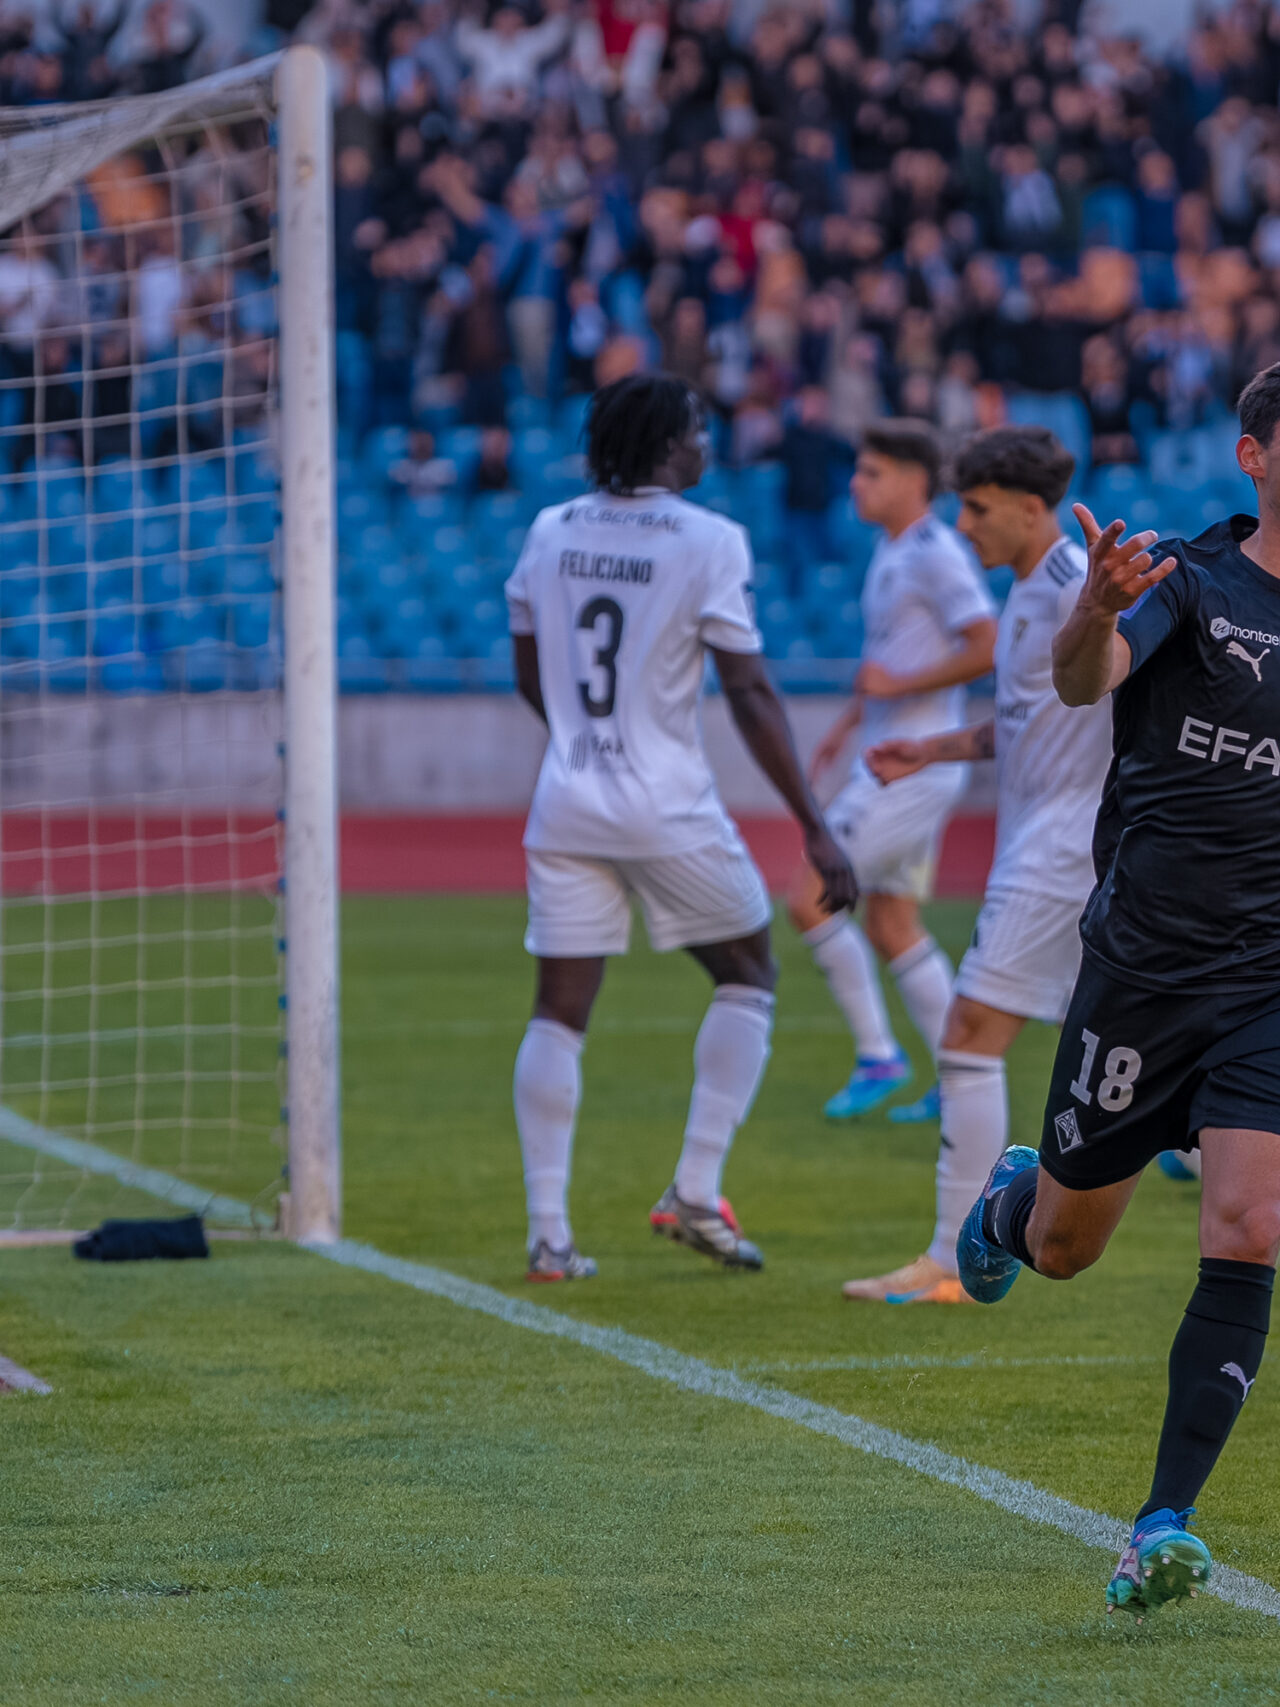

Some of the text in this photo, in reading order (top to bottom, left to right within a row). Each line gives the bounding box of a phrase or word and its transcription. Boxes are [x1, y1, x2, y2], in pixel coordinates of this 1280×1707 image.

[559, 549, 653, 585] FELICIANO
[574, 596, 624, 718] 3
[1070, 1027, 1142, 1112] 18
